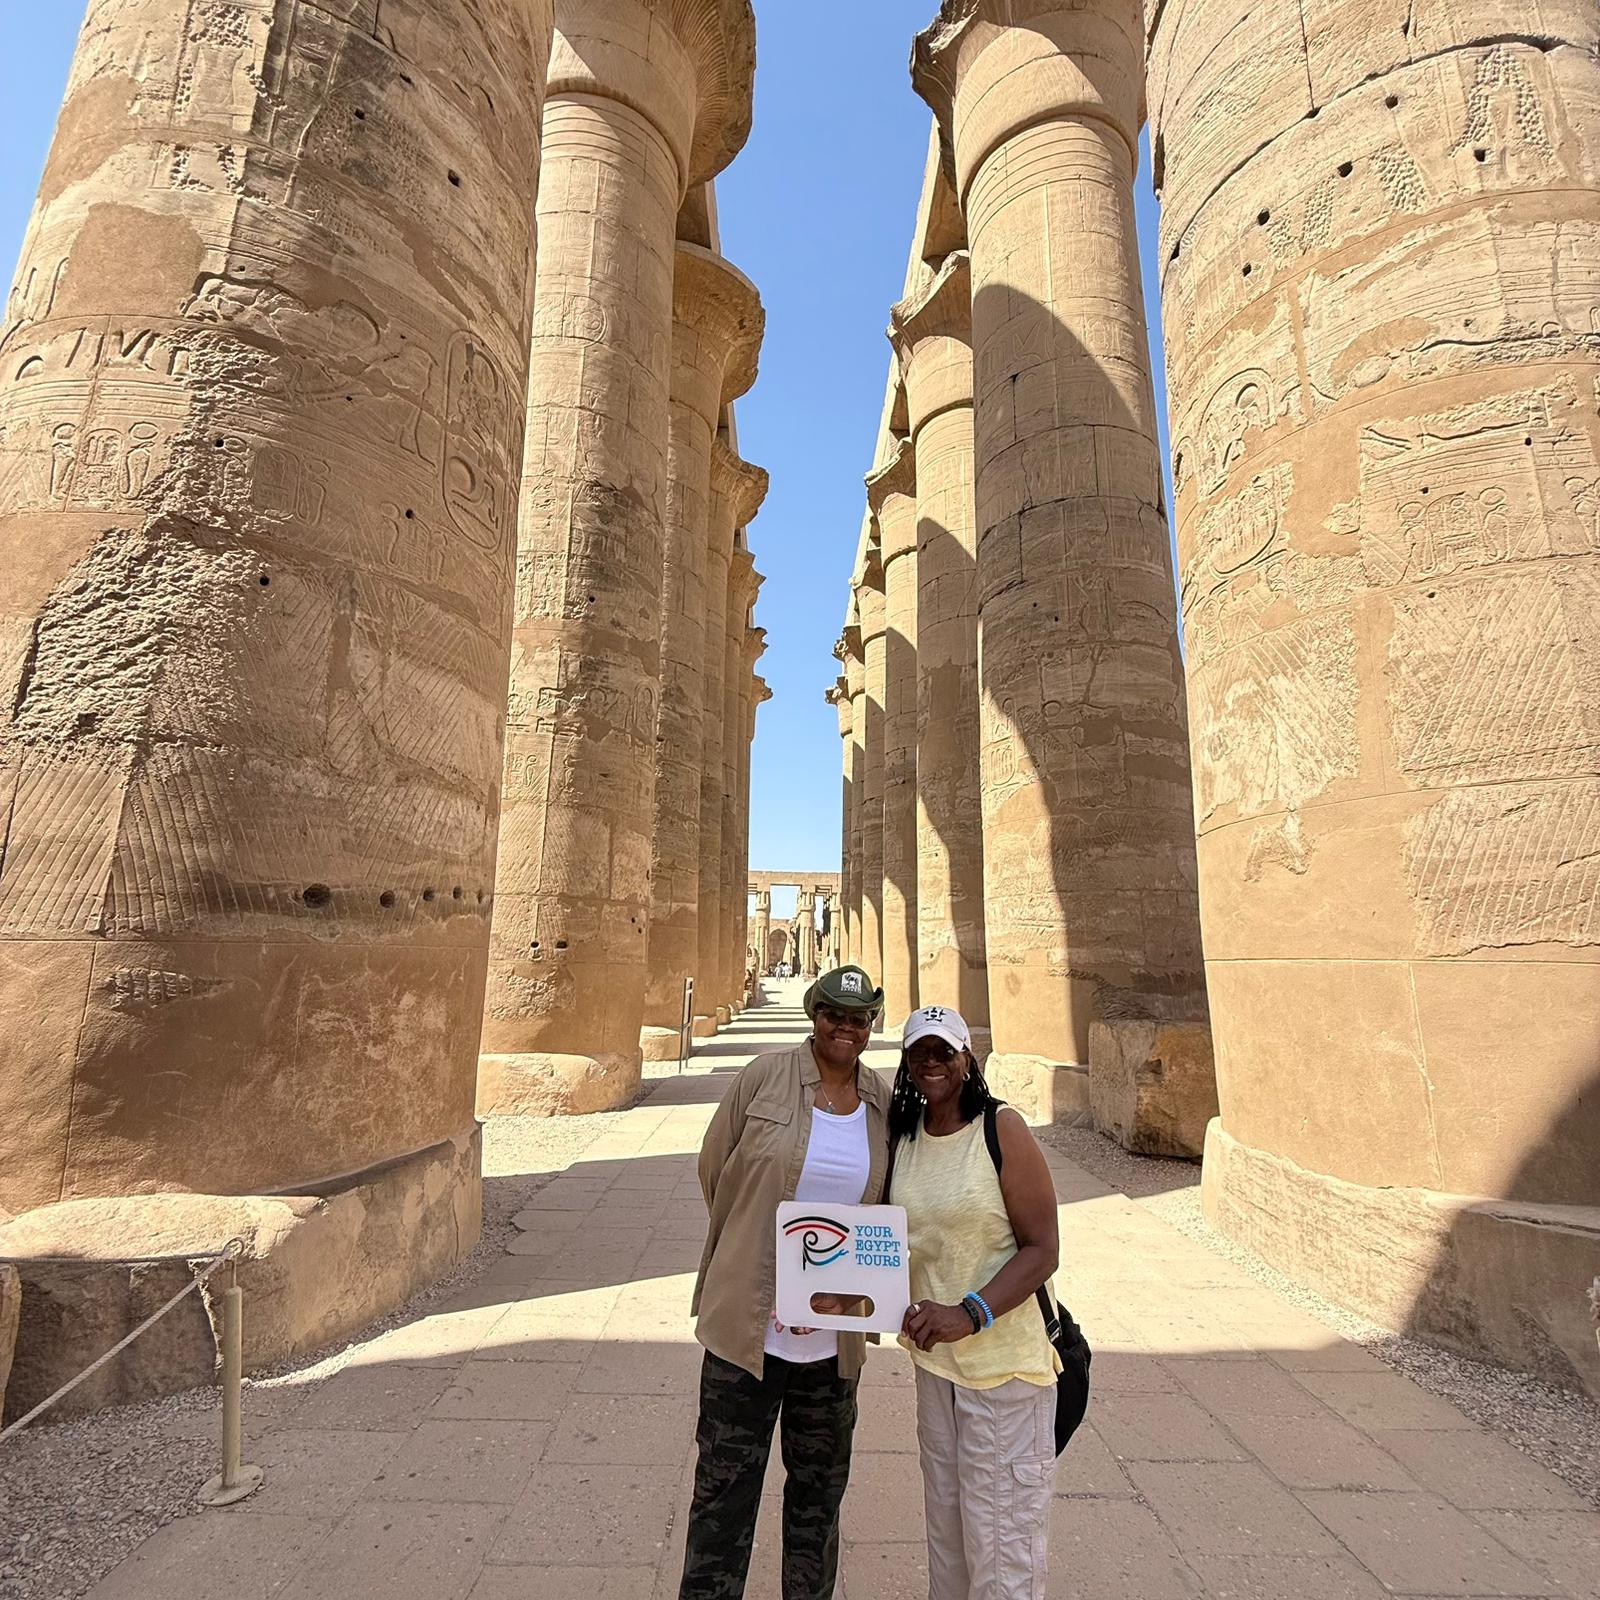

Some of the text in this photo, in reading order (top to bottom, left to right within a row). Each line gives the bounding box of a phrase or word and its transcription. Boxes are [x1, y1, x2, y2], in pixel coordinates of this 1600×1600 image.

[854, 1225, 892, 1238] YOUR
[855, 1239, 901, 1252] EGYPT
[855, 1253, 901, 1267] TOURS
